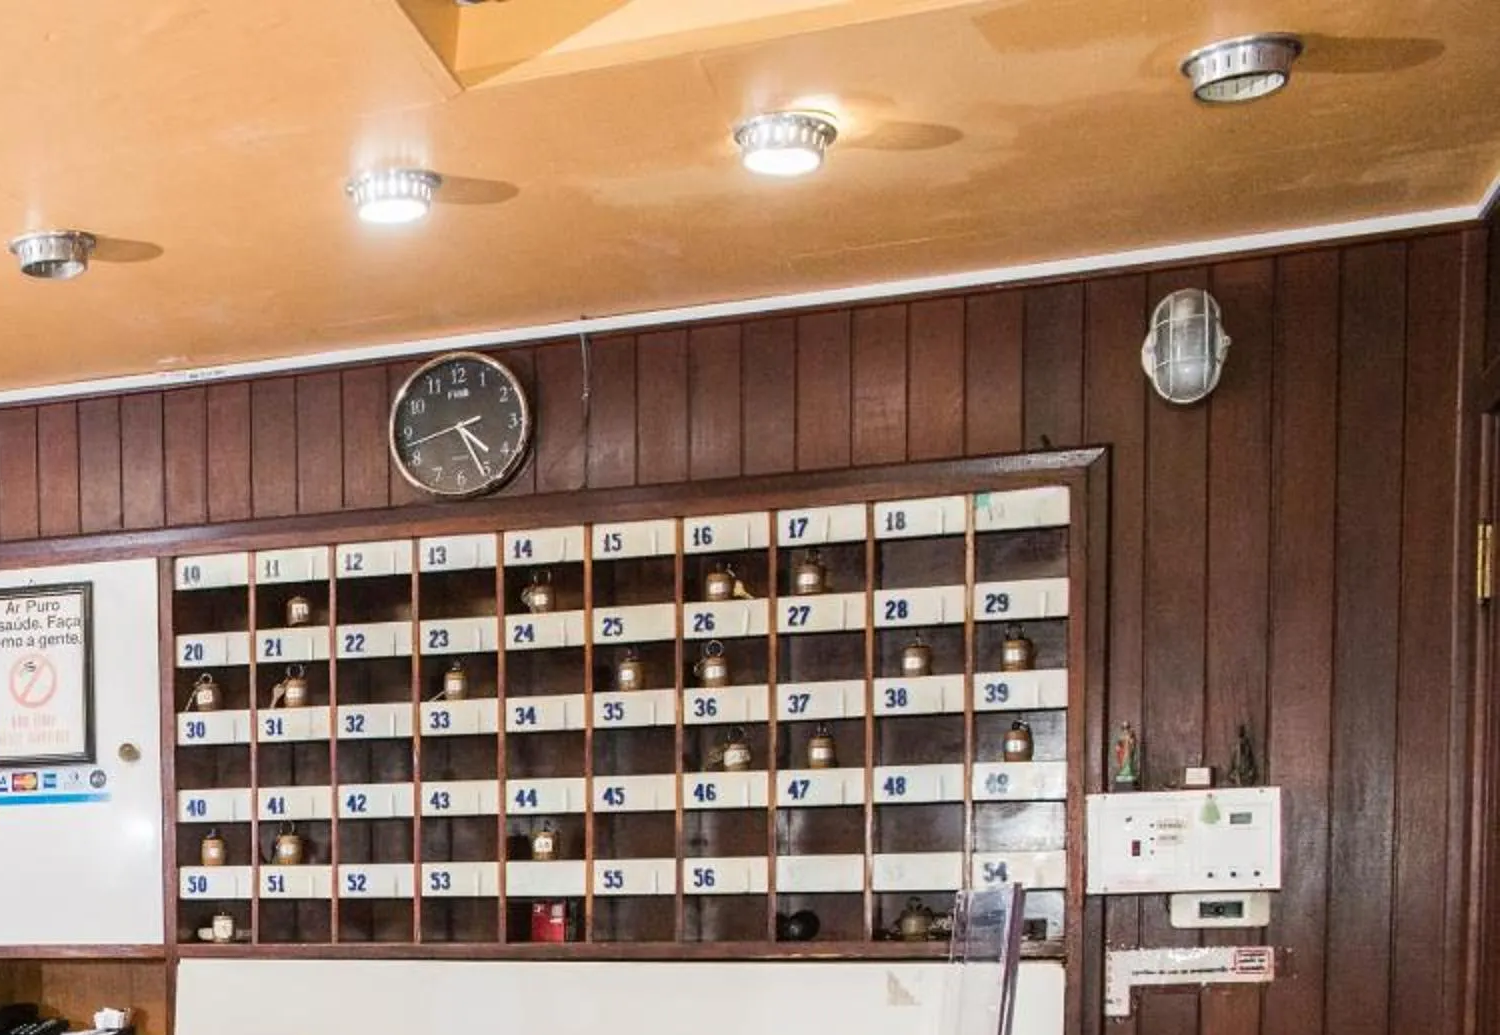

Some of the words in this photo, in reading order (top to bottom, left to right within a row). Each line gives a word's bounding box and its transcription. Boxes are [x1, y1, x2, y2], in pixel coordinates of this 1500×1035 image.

[451, 367, 468, 385] 12
[480, 372, 487, 388] 1
[426, 379, 441, 395] 11
[499, 387, 509, 403] 2
[410, 400, 425, 415] 10
[507, 413, 518, 429] 3
[403, 426, 413, 440] 9
[411, 450, 421, 465] 8
[432, 466, 443, 482] 7
[456, 471, 466, 486] 6
[789, 518, 808, 538] 17
[886, 512, 906, 531] 18
[604, 533, 622, 552] 15
[693, 526, 712, 546] 16
[429, 546, 446, 565] 13
[514, 540, 532, 558] 14
[266, 560, 279, 578] 11
[345, 553, 363, 571] 12
[183, 566, 200, 584] 10
[5, 600, 21, 615] Ar
[25, 599, 61, 613] Puro
[885, 600, 908, 620] 28
[985, 594, 1009, 613] 29
[47, 614, 82, 630] Faça
[694, 613, 715, 632] 26
[788, 606, 810, 626] 27
[514, 624, 534, 643] 24
[603, 618, 623, 636] 25
[265, 639, 282, 656] 21
[346, 634, 364, 652] 22
[429, 630, 448, 648] 23
[184, 644, 203, 661] 20
[885, 688, 907, 708] 38
[984, 683, 1009, 703] 39
[604, 702, 624, 720] 35
[694, 698, 717, 717] 36
[788, 694, 810, 713] 37
[346, 714, 364, 732] 32
[430, 711, 450, 729] 33
[516, 706, 536, 725] 34
[186, 722, 205, 738] 30
[266, 718, 283, 736] 31
[694, 784, 716, 802] 46
[788, 780, 810, 799] 47
[884, 776, 906, 796] 48
[268, 797, 284, 814] 41
[347, 794, 366, 812] 42
[430, 792, 450, 810] 43
[515, 789, 537, 807] 44
[603, 788, 624, 805] 45
[187, 800, 206, 816] 40
[431, 872, 450, 890] 53
[604, 870, 623, 888] 55
[694, 868, 714, 887] 56
[984, 862, 1007, 883] 54
[188, 876, 207, 893] 50
[268, 875, 284, 892] 51
[348, 874, 366, 892] 52
